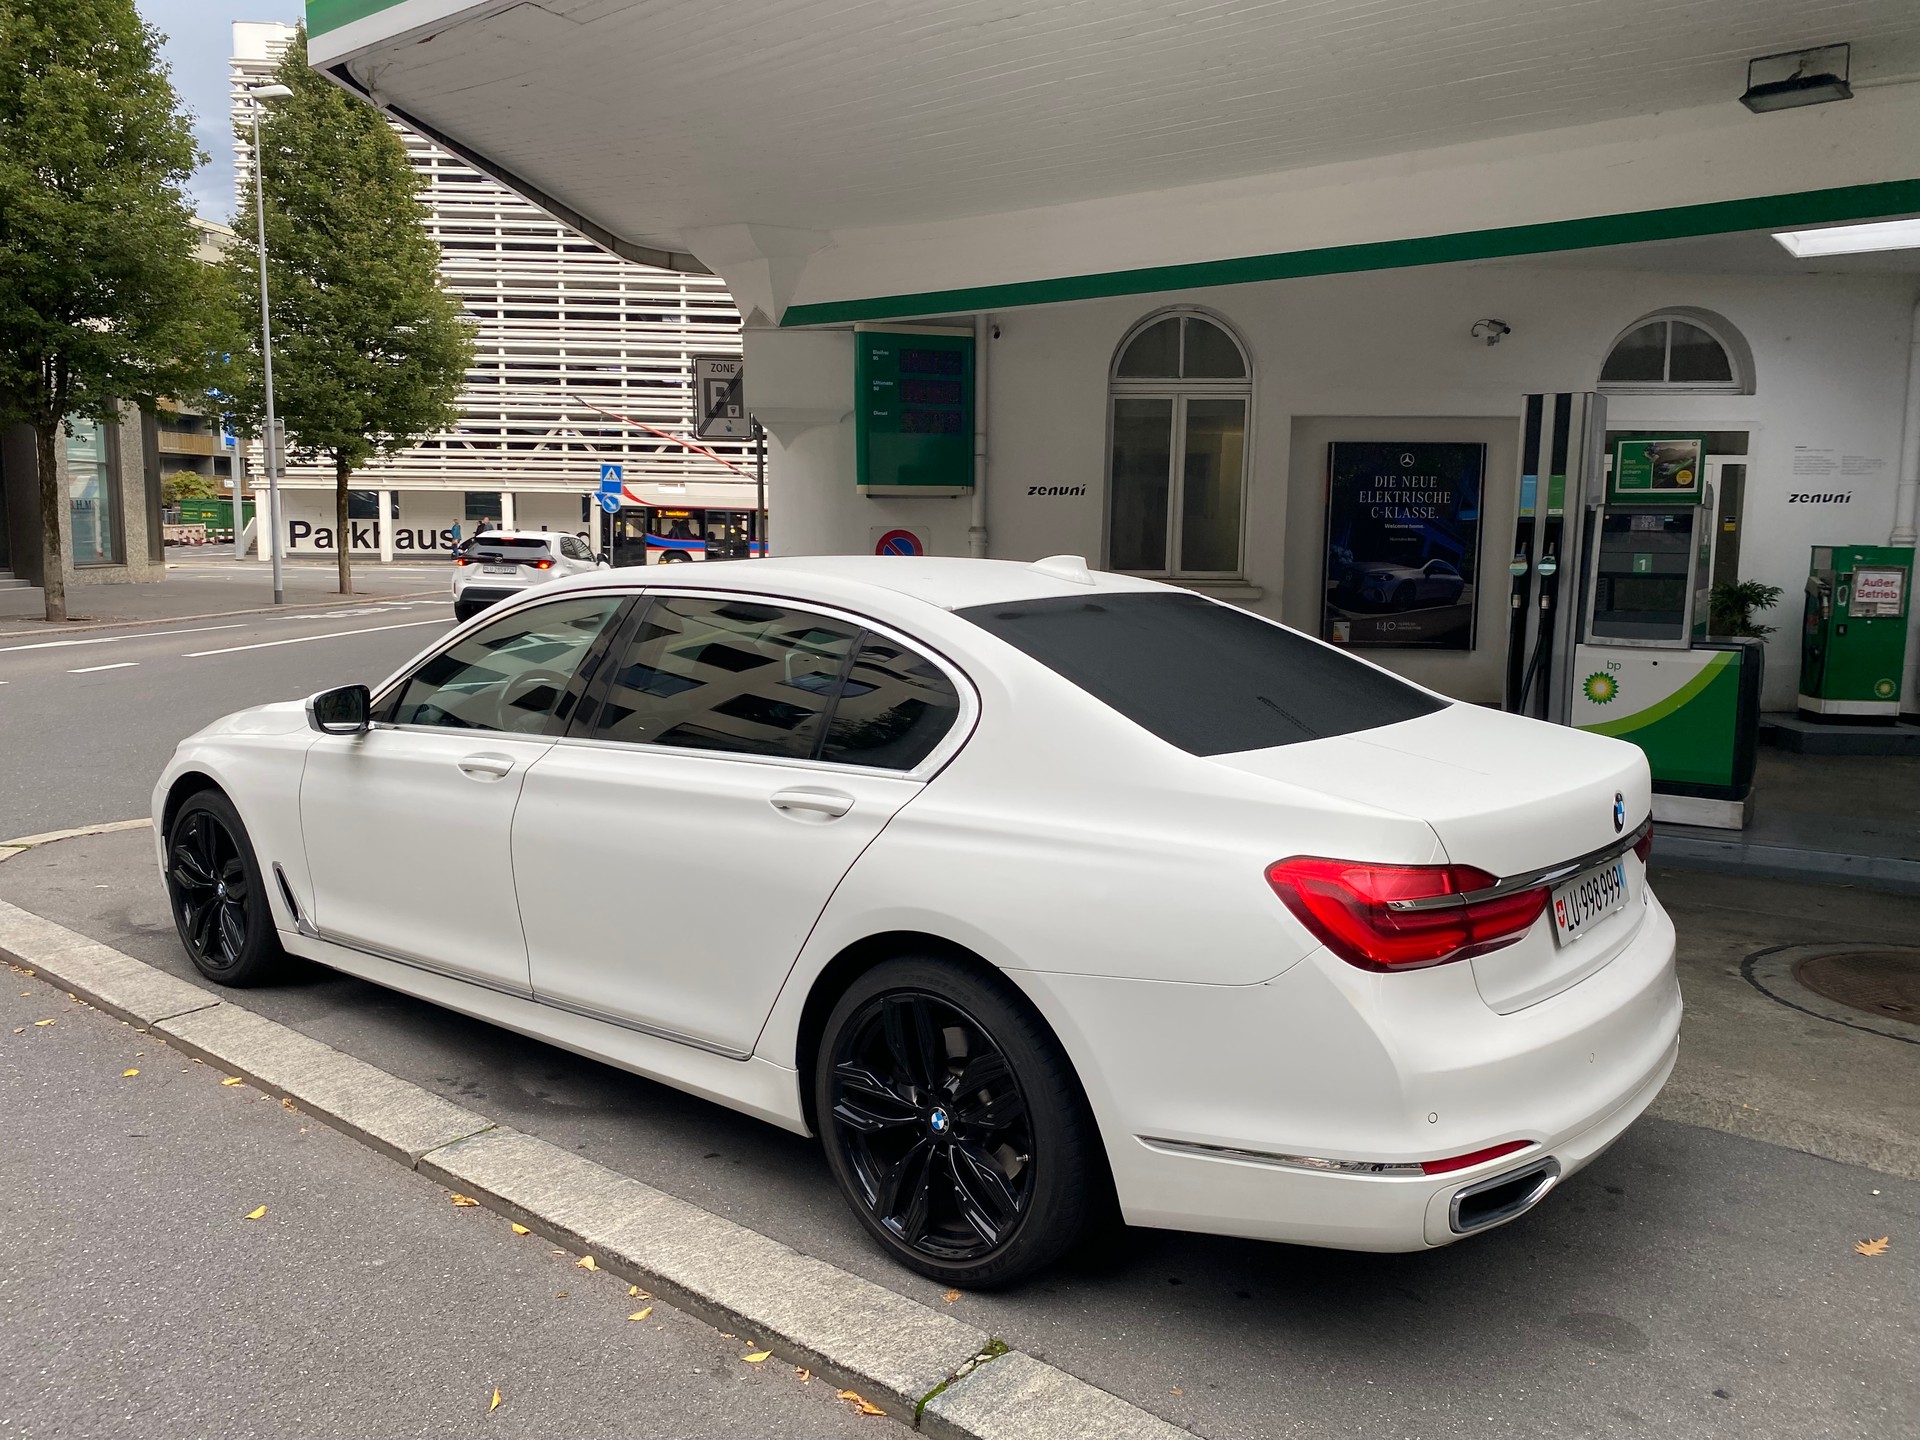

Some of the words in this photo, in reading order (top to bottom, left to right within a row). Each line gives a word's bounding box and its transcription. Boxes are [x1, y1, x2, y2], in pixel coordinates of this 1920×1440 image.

[710, 363, 735, 373] ZONE
[1374, 475, 1397, 488] DIE
[1402, 475, 1438, 488] NEUE
[1027, 484, 1087, 496] zenuni
[1359, 491, 1451, 504] ELEKTRISCHE
[1788, 491, 1852, 504] zenuni
[1371, 506, 1439, 519] C-KLASSE.
[289, 520, 453, 550] Pakaus
[1639, 558, 1647, 571] 1
[1862, 578, 1896, 588] Außer
[1857, 589, 1898, 599] Betrieb
[1606, 659, 1622, 671] bp
